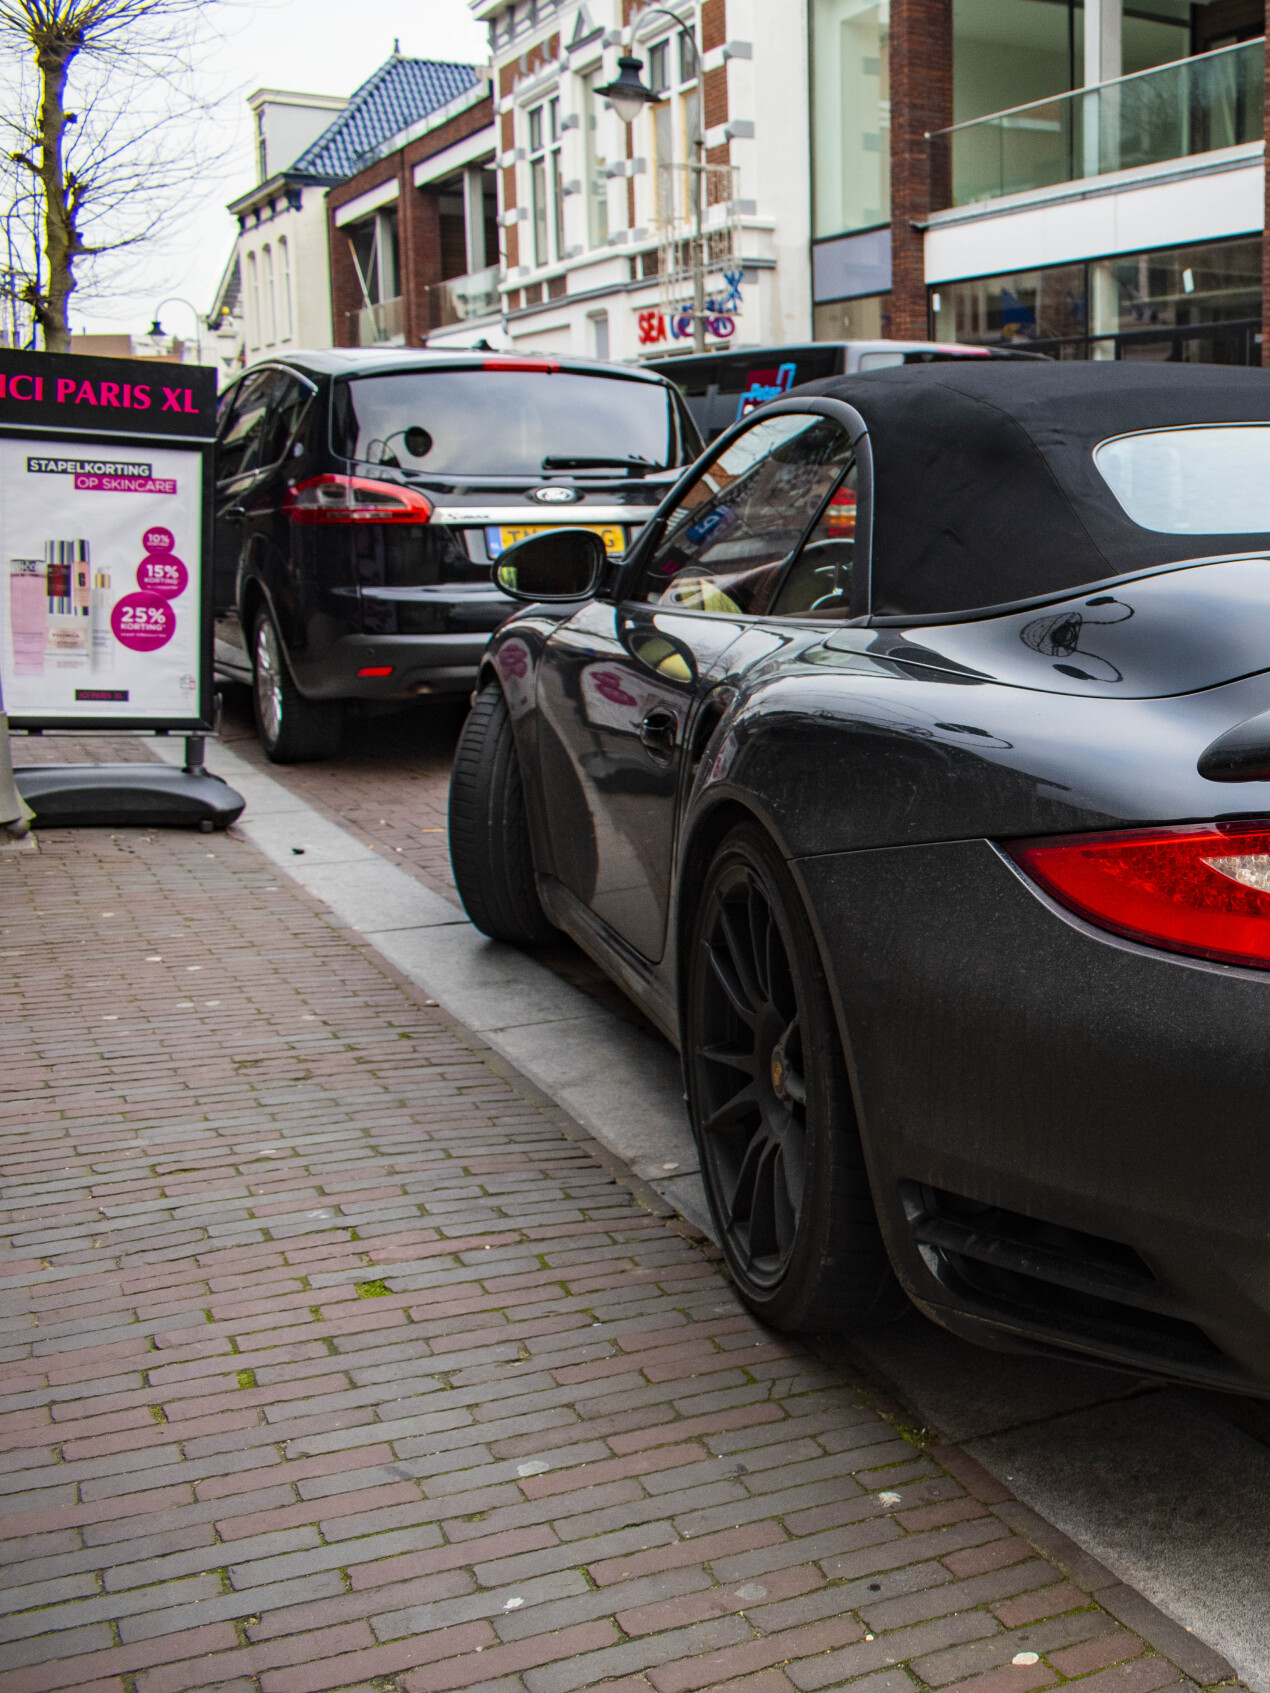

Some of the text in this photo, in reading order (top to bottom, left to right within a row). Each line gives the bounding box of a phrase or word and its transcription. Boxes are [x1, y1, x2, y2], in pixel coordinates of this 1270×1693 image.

[638, 310, 667, 345] SEA
[0, 373, 200, 414] ICI PARIS XL
[30, 459, 150, 476] STAPELKORTING
[77, 476, 175, 493] OP SKINCARE
[147, 533, 171, 544] 10%
[146, 564, 180, 578] 15%
[121, 606, 166, 623] 25%
